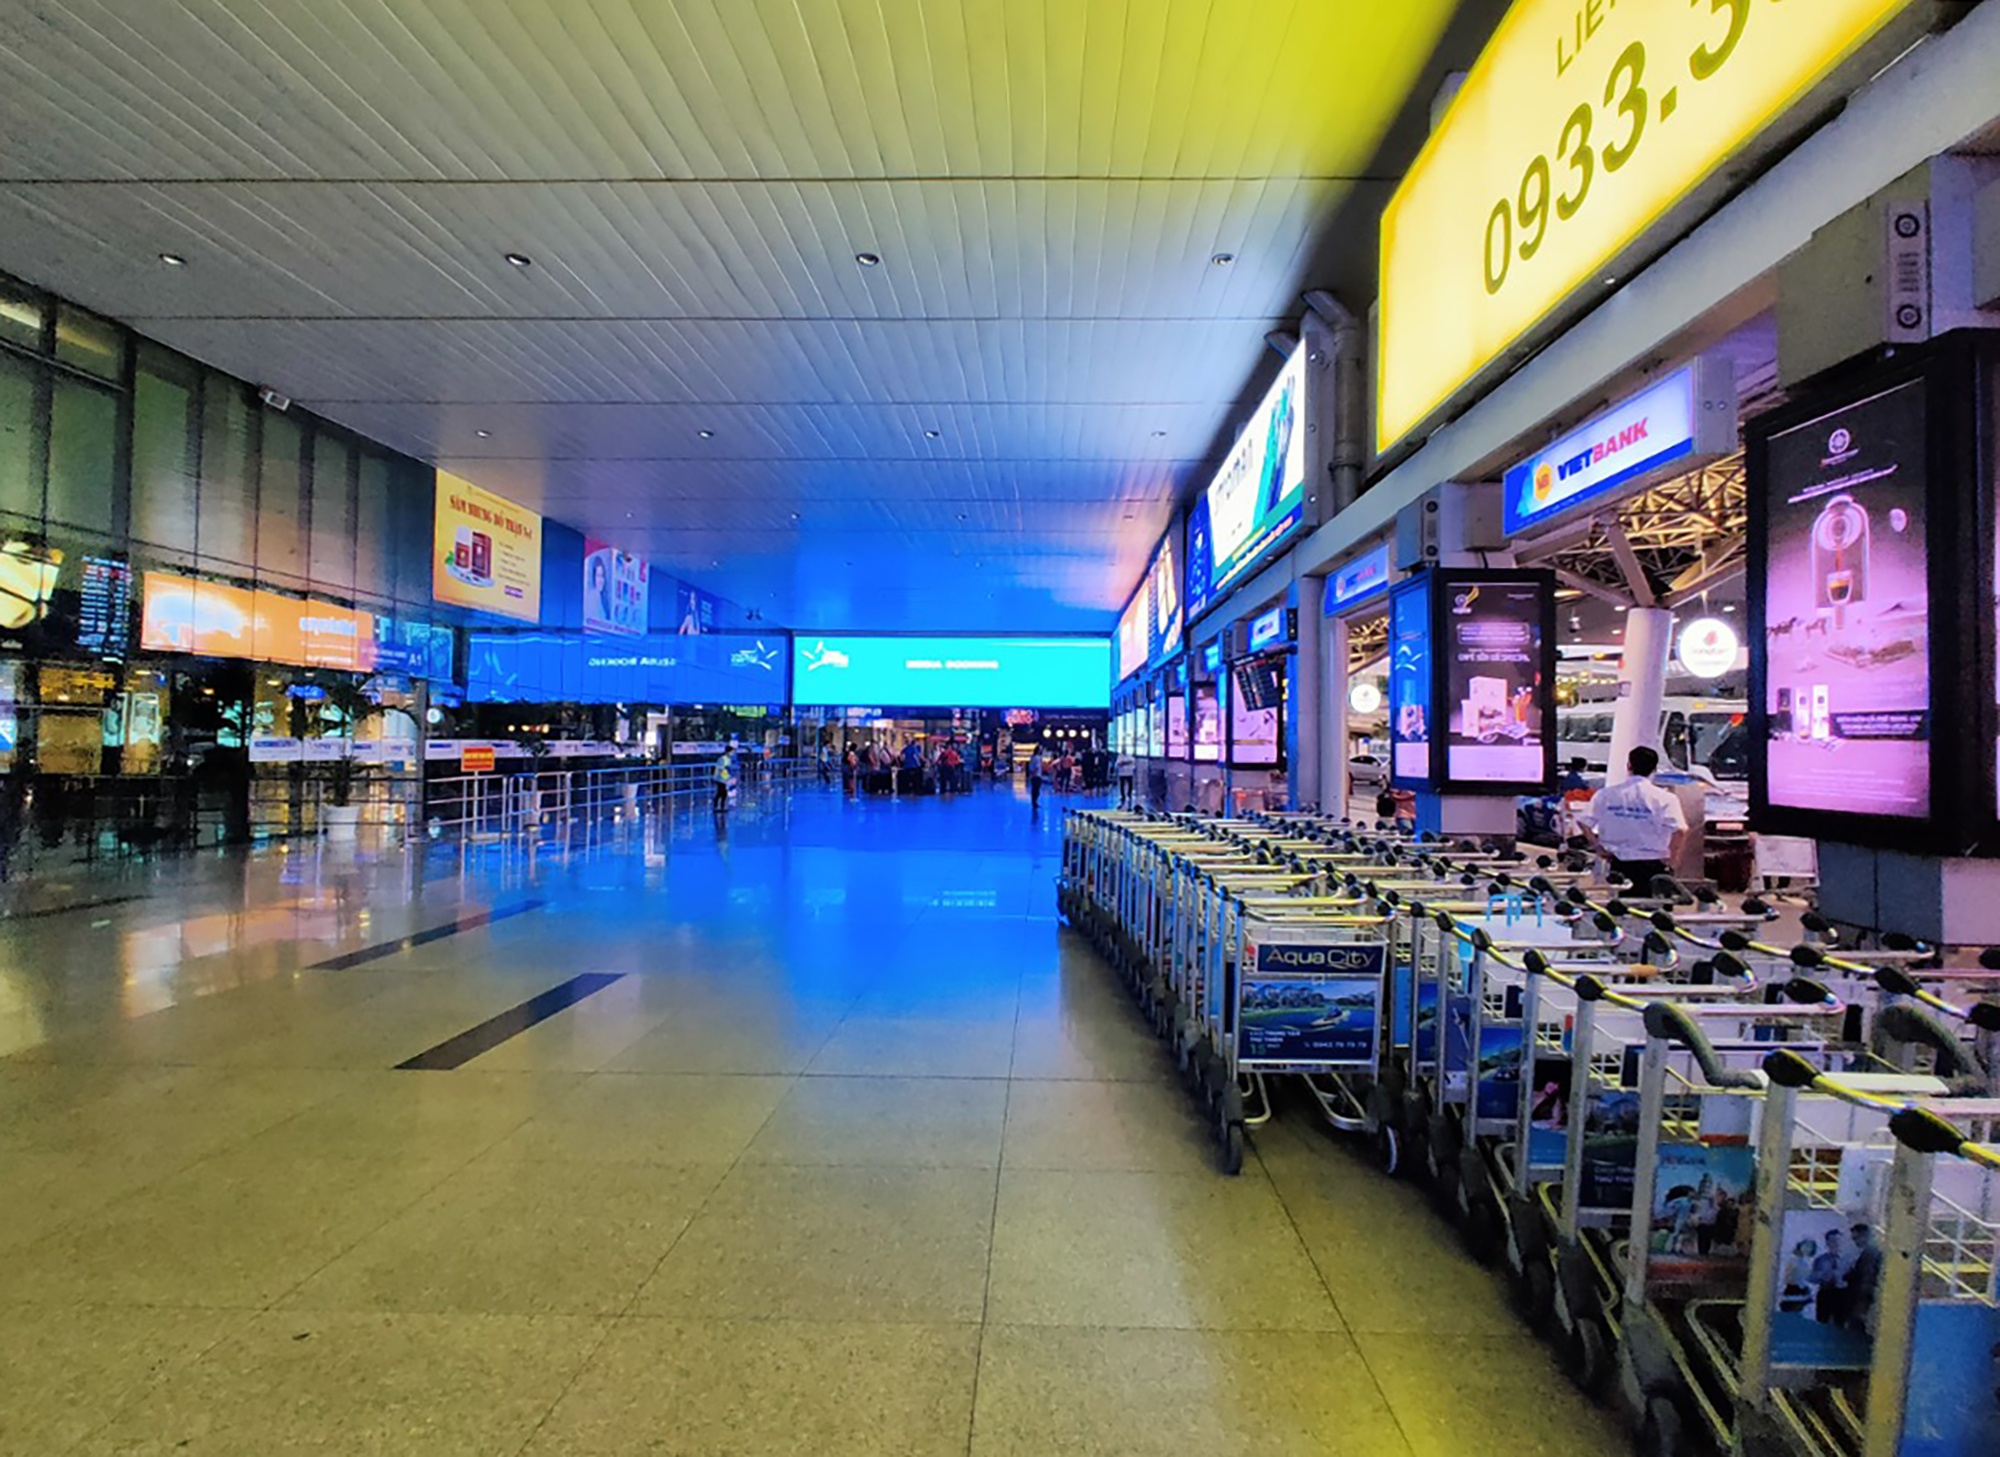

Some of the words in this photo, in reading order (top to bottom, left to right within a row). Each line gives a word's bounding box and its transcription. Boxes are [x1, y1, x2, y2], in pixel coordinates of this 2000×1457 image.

[1556, 0, 1616, 78] LIE
[1482, 0, 1784, 296] 0933.3
[1557, 416, 1649, 481] VIETBANK
[408, 652, 422, 666] A1
